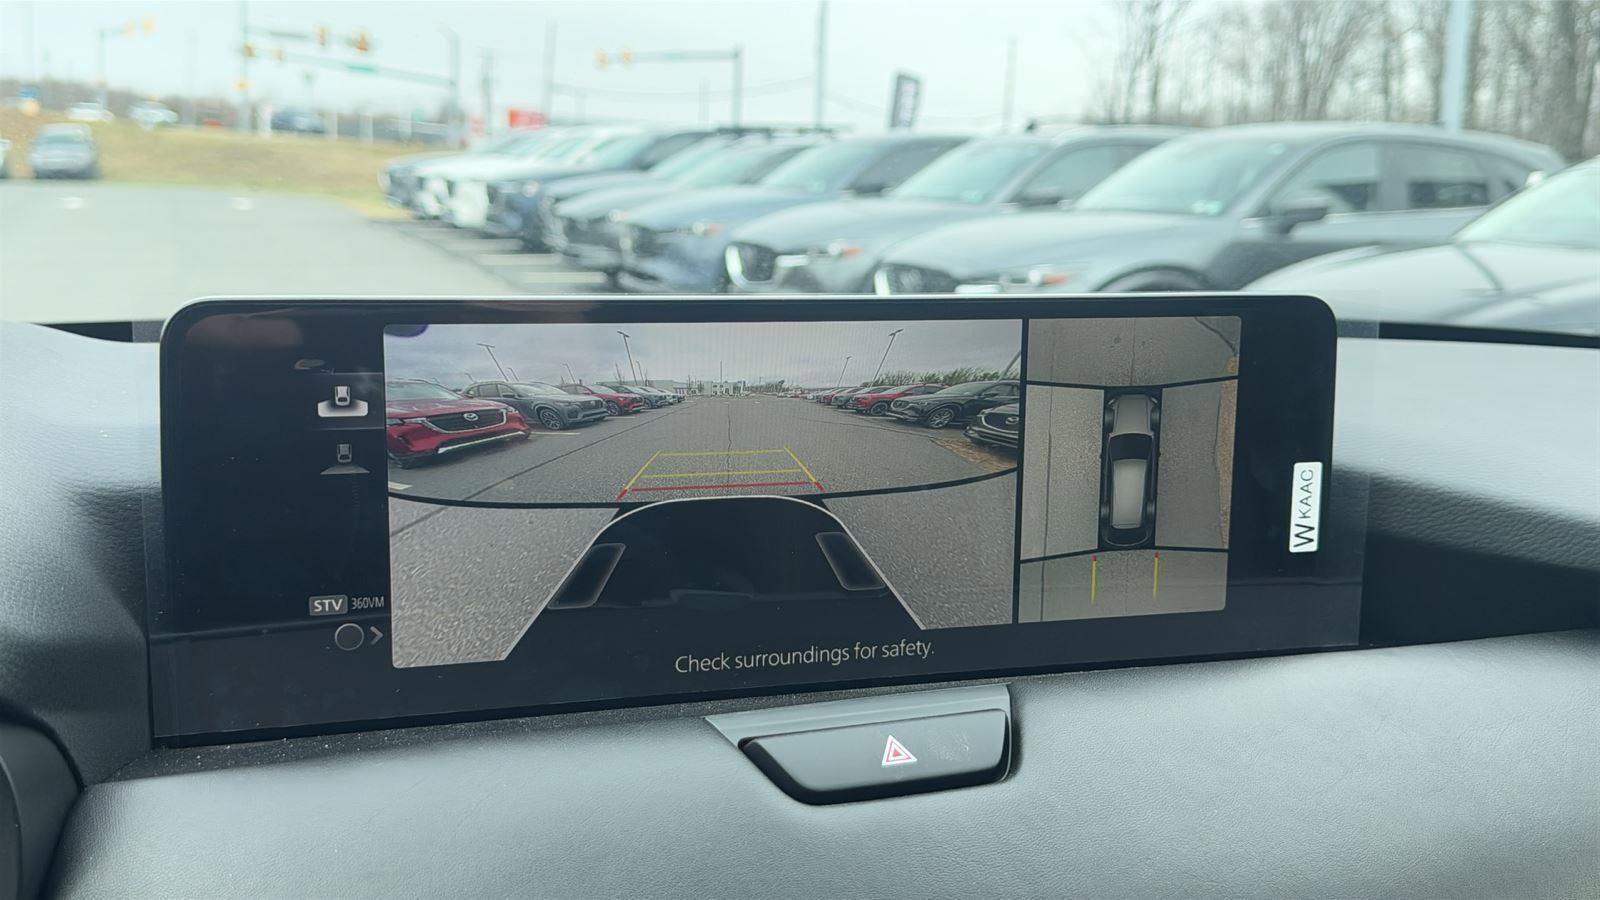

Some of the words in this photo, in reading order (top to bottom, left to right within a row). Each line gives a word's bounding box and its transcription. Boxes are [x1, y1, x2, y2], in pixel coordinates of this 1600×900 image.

[313, 598, 344, 612] STV
[351, 596, 385, 610] 360VM
[674, 652, 731, 673] Check
[734, 645, 850, 666] surroundings
[853, 641, 879, 660] for
[881, 638, 935, 659] safety.
